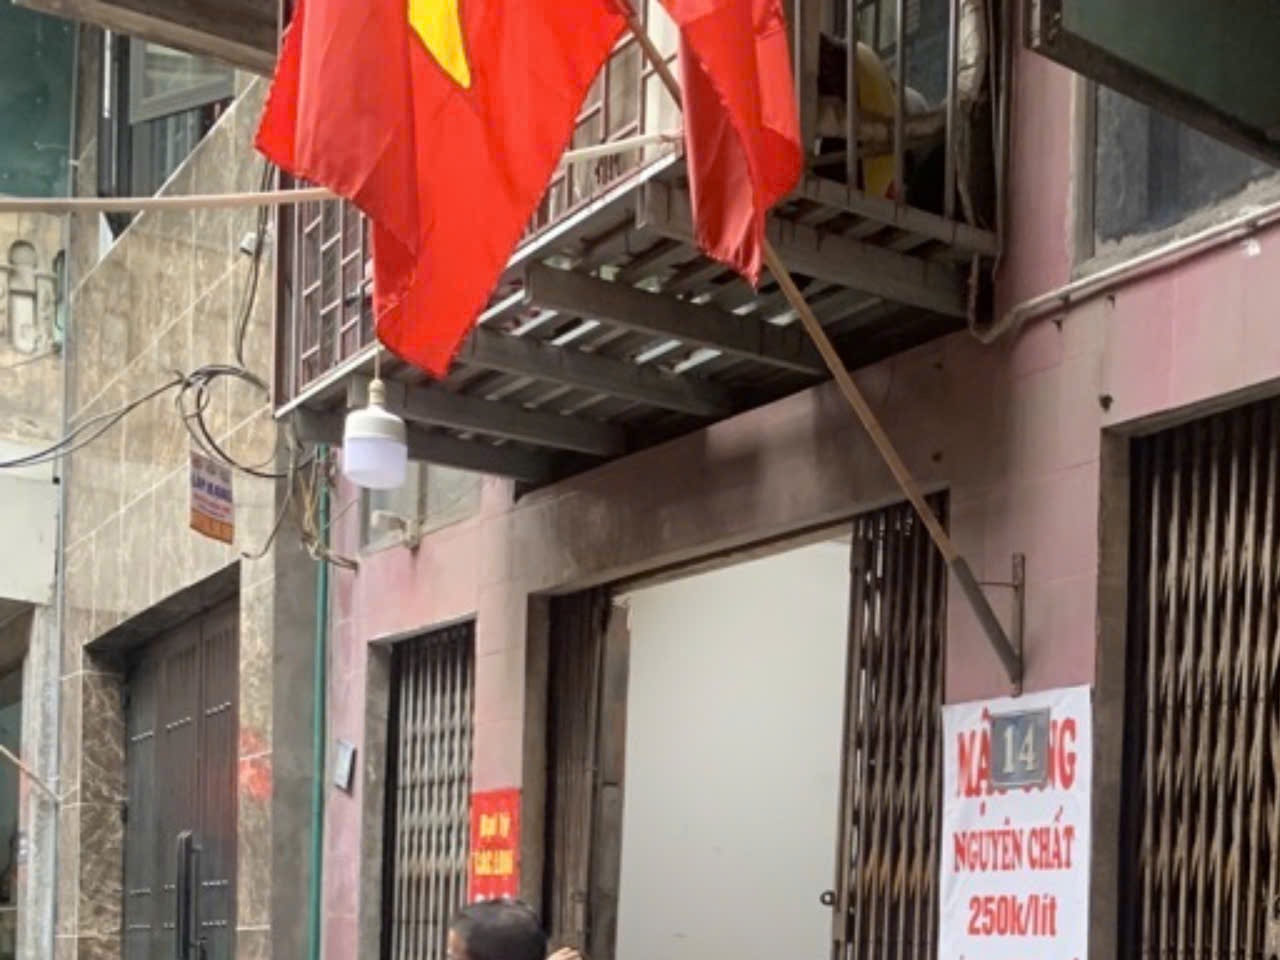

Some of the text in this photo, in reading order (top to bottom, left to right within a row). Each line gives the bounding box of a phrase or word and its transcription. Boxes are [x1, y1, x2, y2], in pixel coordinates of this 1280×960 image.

[1003, 723, 1036, 774] 14
[953, 805, 1075, 872] NGUYÊN CHẤT
